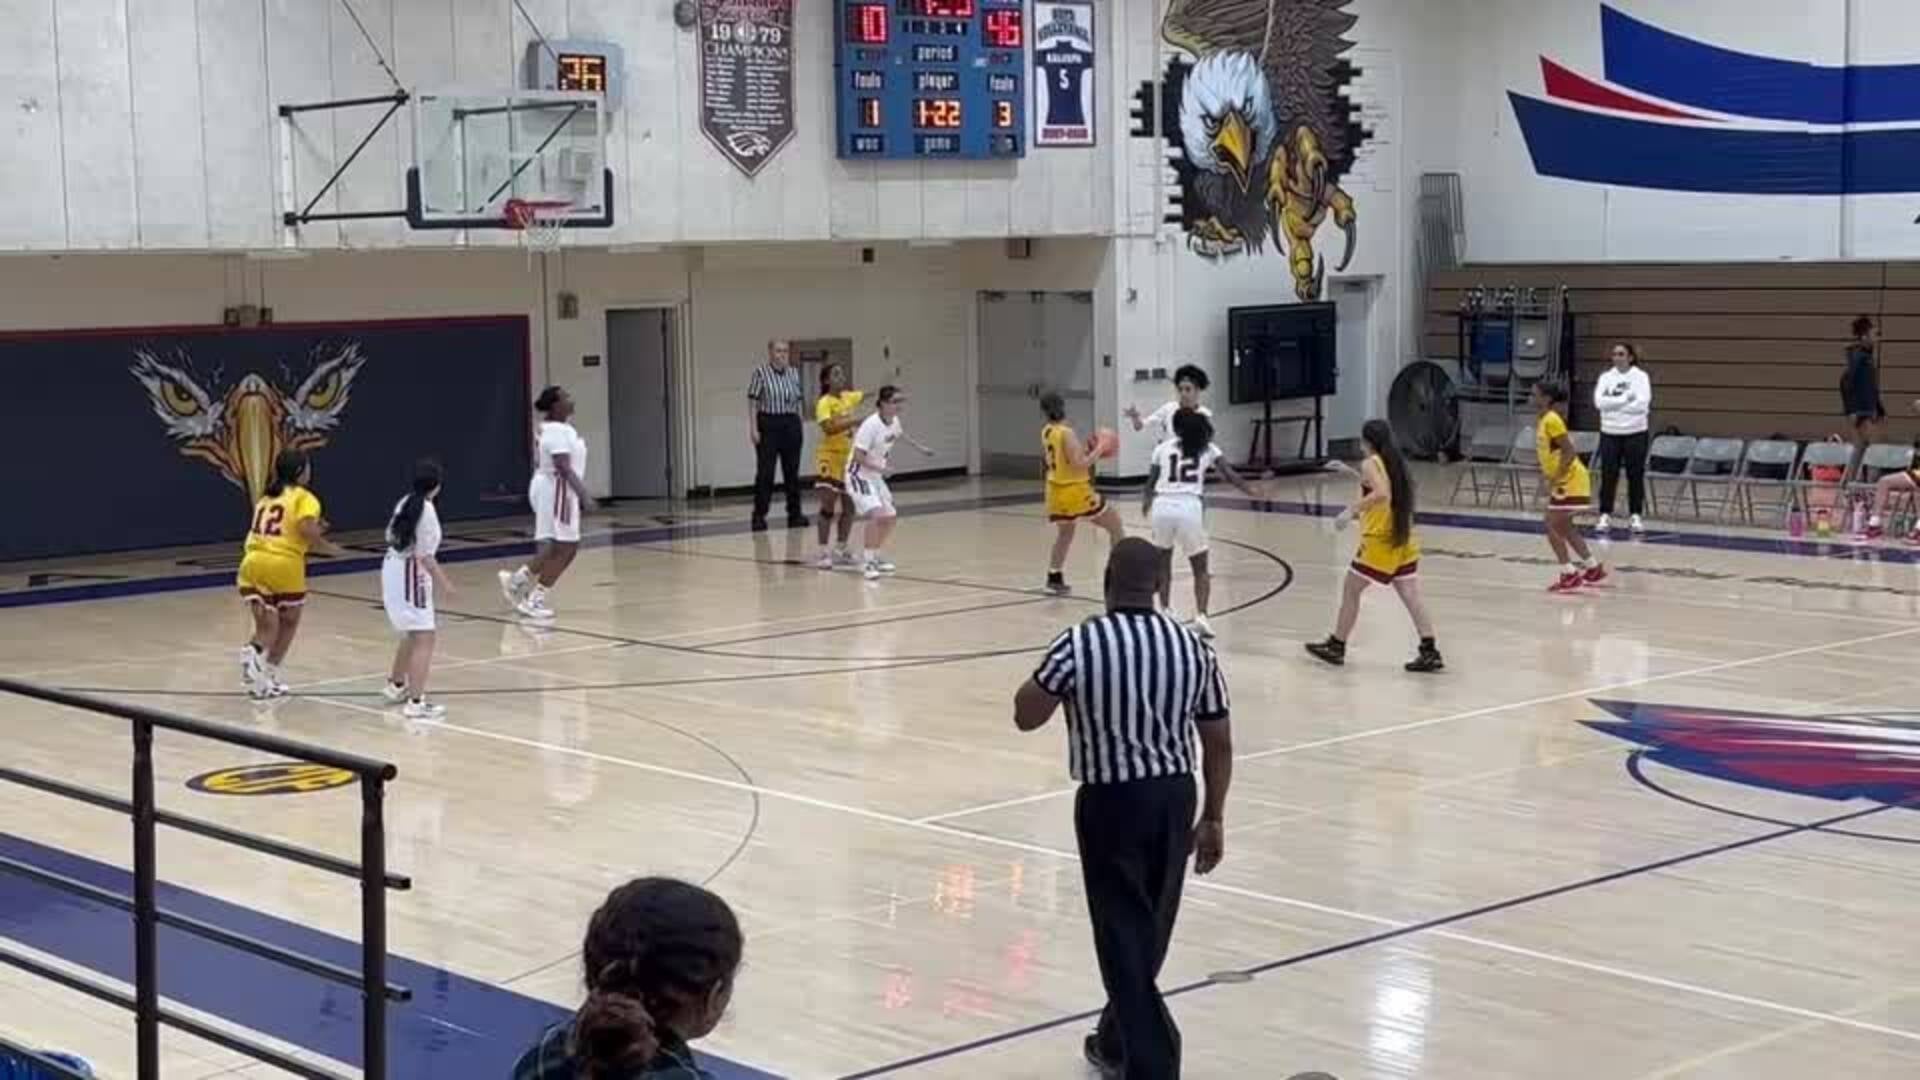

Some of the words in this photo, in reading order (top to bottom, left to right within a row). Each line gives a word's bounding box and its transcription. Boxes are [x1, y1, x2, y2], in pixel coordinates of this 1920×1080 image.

[711, 23, 731, 41] 19
[759, 27, 781, 44] 79
[987, 11, 1019, 45] 46
[918, 47, 953, 61] period
[561, 57, 601, 91] 26
[855, 72, 882, 88] fouls
[919, 73, 954, 90] player
[990, 75, 1014, 90] fouls
[1059, 68, 1070, 89] 5
[999, 101, 1011, 126] 3
[1168, 453, 1199, 482] 12
[253, 505, 284, 536] 12
